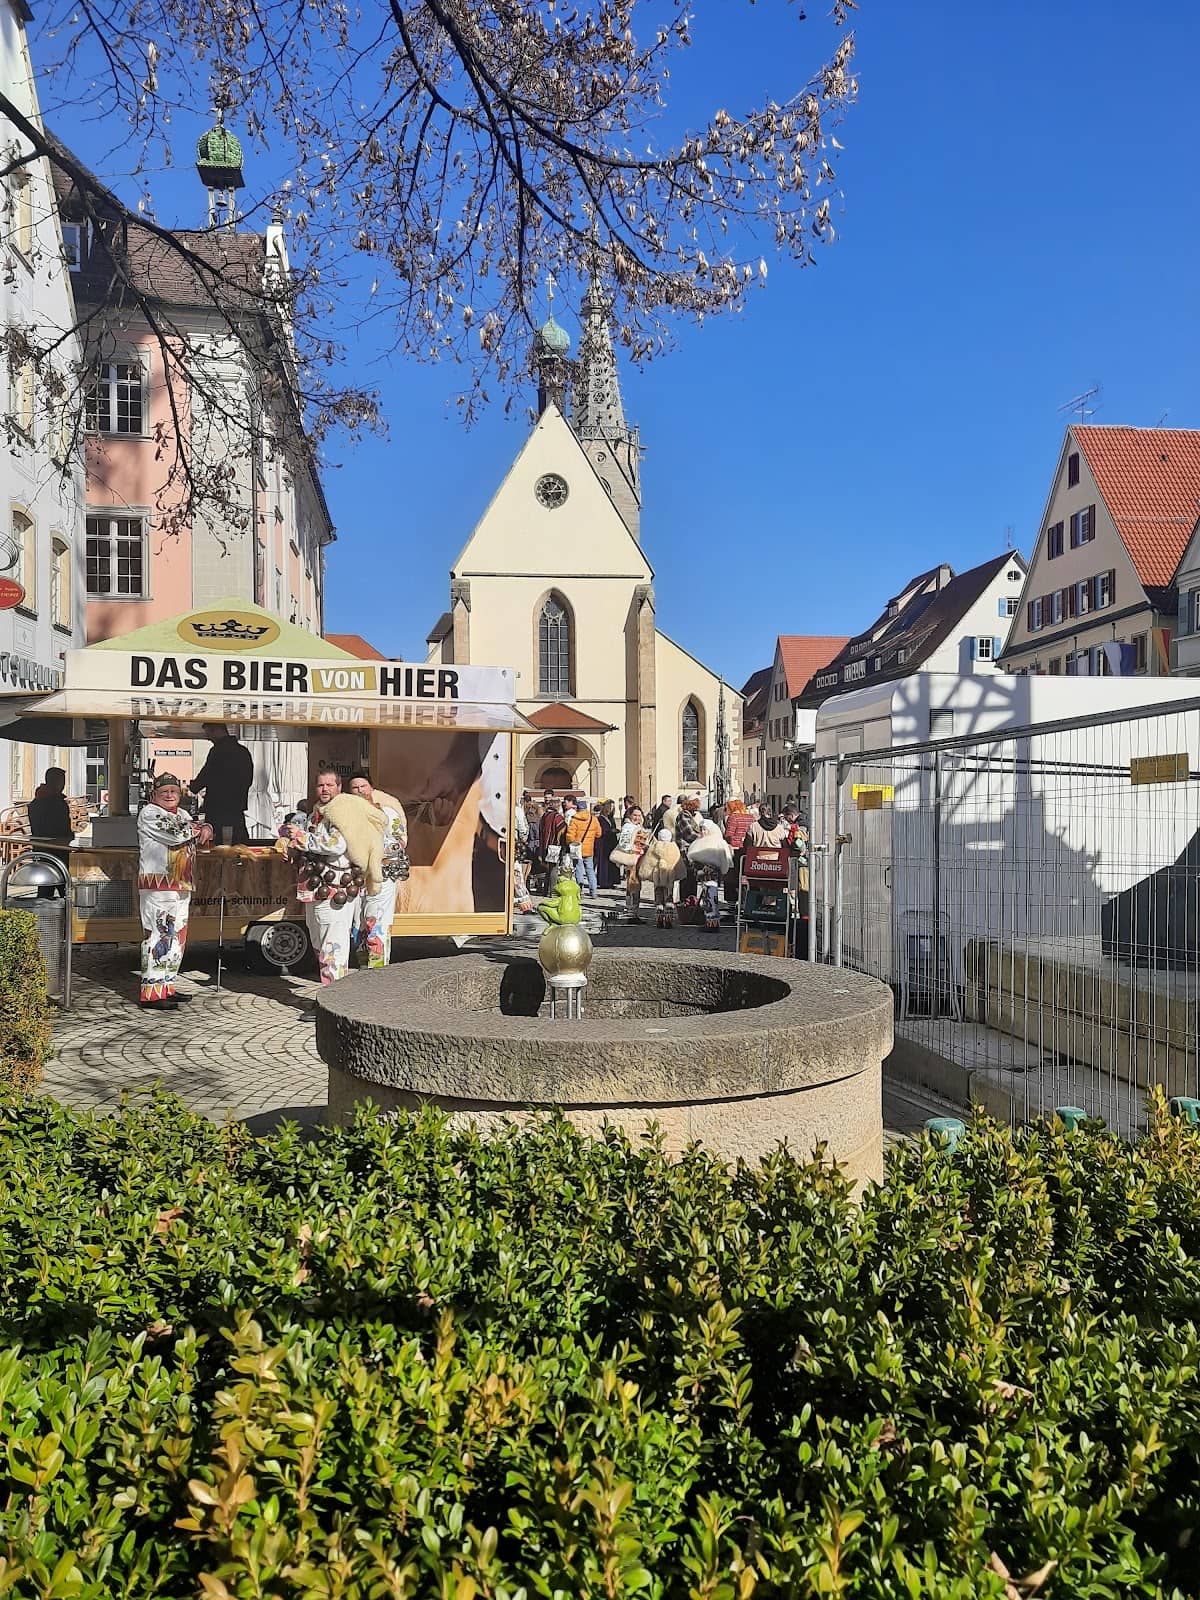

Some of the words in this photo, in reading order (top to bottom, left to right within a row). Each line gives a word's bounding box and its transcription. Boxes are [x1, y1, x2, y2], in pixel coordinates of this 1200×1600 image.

[131, 656, 208, 689] DAS
[223, 661, 308, 693] BIER
[320, 670, 365, 690] VON
[380, 667, 459, 698] HIER
[750, 860, 782, 871] Rothaus
[189, 895, 288, 906] rauerei-schimpf.de
